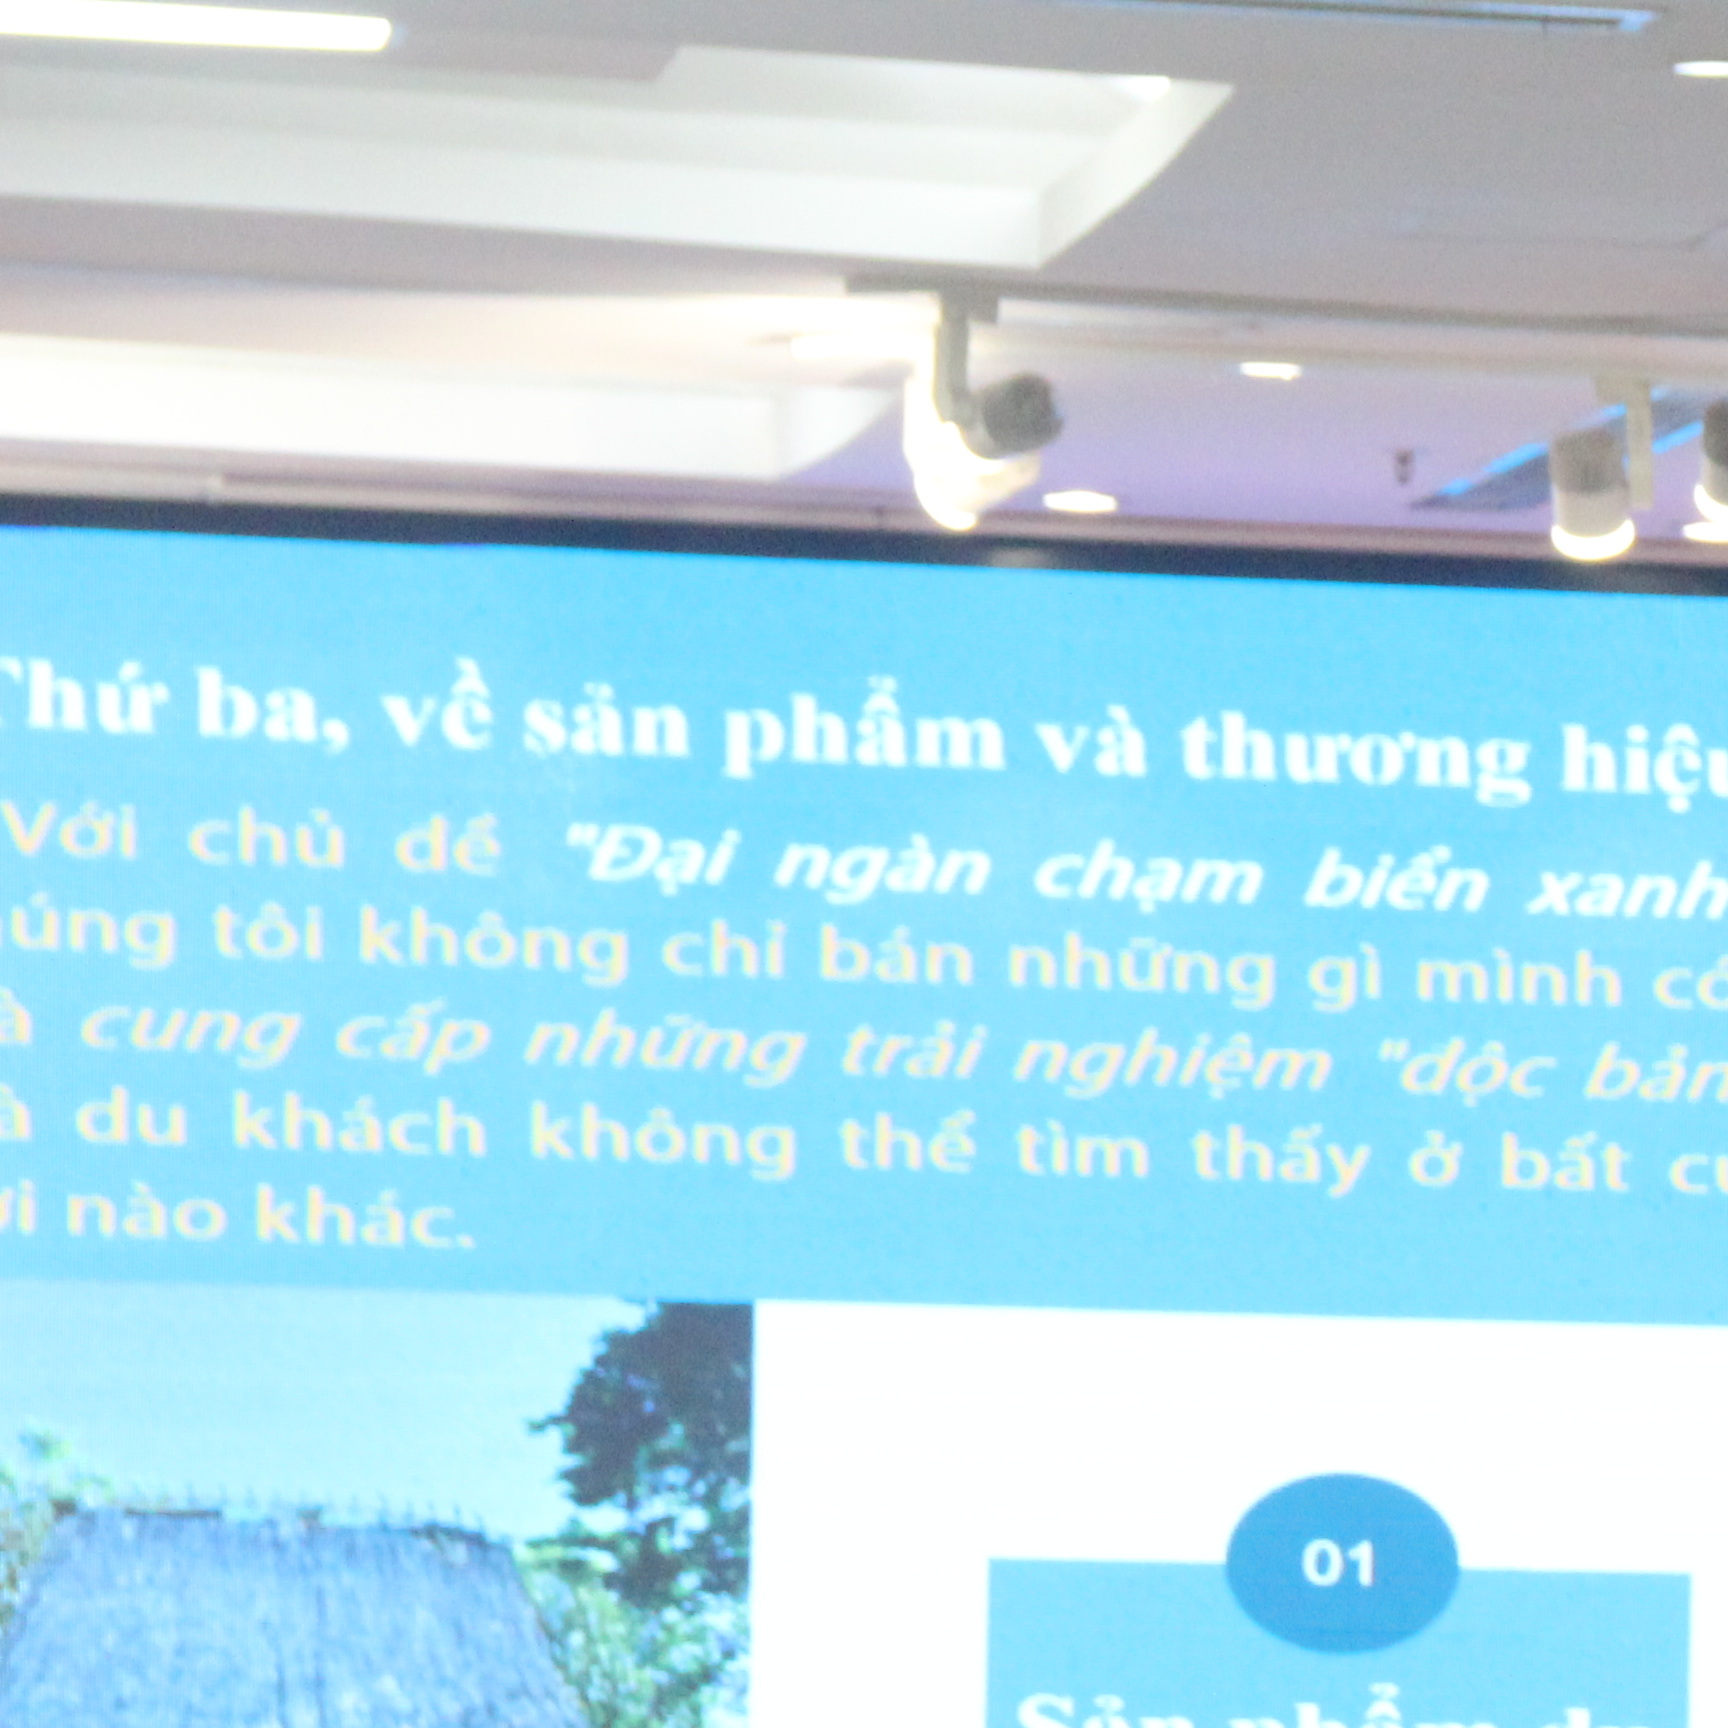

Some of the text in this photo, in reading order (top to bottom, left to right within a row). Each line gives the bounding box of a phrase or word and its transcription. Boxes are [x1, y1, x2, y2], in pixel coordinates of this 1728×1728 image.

[197, 666, 350, 752] ba,
[382, 658, 493, 751] về
[522, 683, 690, 758] sản
[724, 676, 1006, 780] phẩm
[1036, 705, 1147, 777] và
[1181, 711, 1532, 807] thương
[1, 800, 137, 860] Với
[189, 805, 346, 869] chủ
[565, 822, 740, 896] "Đại
[774, 834, 993, 905] ngàn
[1033, 838, 1264, 914] chạm
[1303, 845, 1491, 913] biển
[0, 892, 177, 970] úng
[214, 902, 324, 961] tôi
[360, 904, 629, 988] không
[662, 919, 787, 979] chỉ
[820, 923, 974, 985] bán
[1009, 930, 1276, 1011] những
[1308, 943, 1382, 1013] gì
[1417, 948, 1623, 1007] mình
[81, 1006, 303, 1069] cung
[336, 1000, 492, 1076] cấp
[524, 1007, 808, 1088] những
[842, 1020, 988, 1079] trải
[1014, 1027, 1333, 1099] nghiệm
[76, 1085, 188, 1146] du
[234, 1090, 487, 1157] khách
[531, 1100, 797, 1181] không
[840, 1109, 977, 1172] thể
[1017, 1120, 1150, 1178] tìm
[1193, 1124, 1371, 1198] thấy
[1409, 1130, 1463, 1187] ở
[1501, 1131, 1629, 1192] bất
[67, 1182, 228, 1241] nào
[256, 1183, 475, 1248] khác.
[1302, 1539, 1375, 1587] 01
